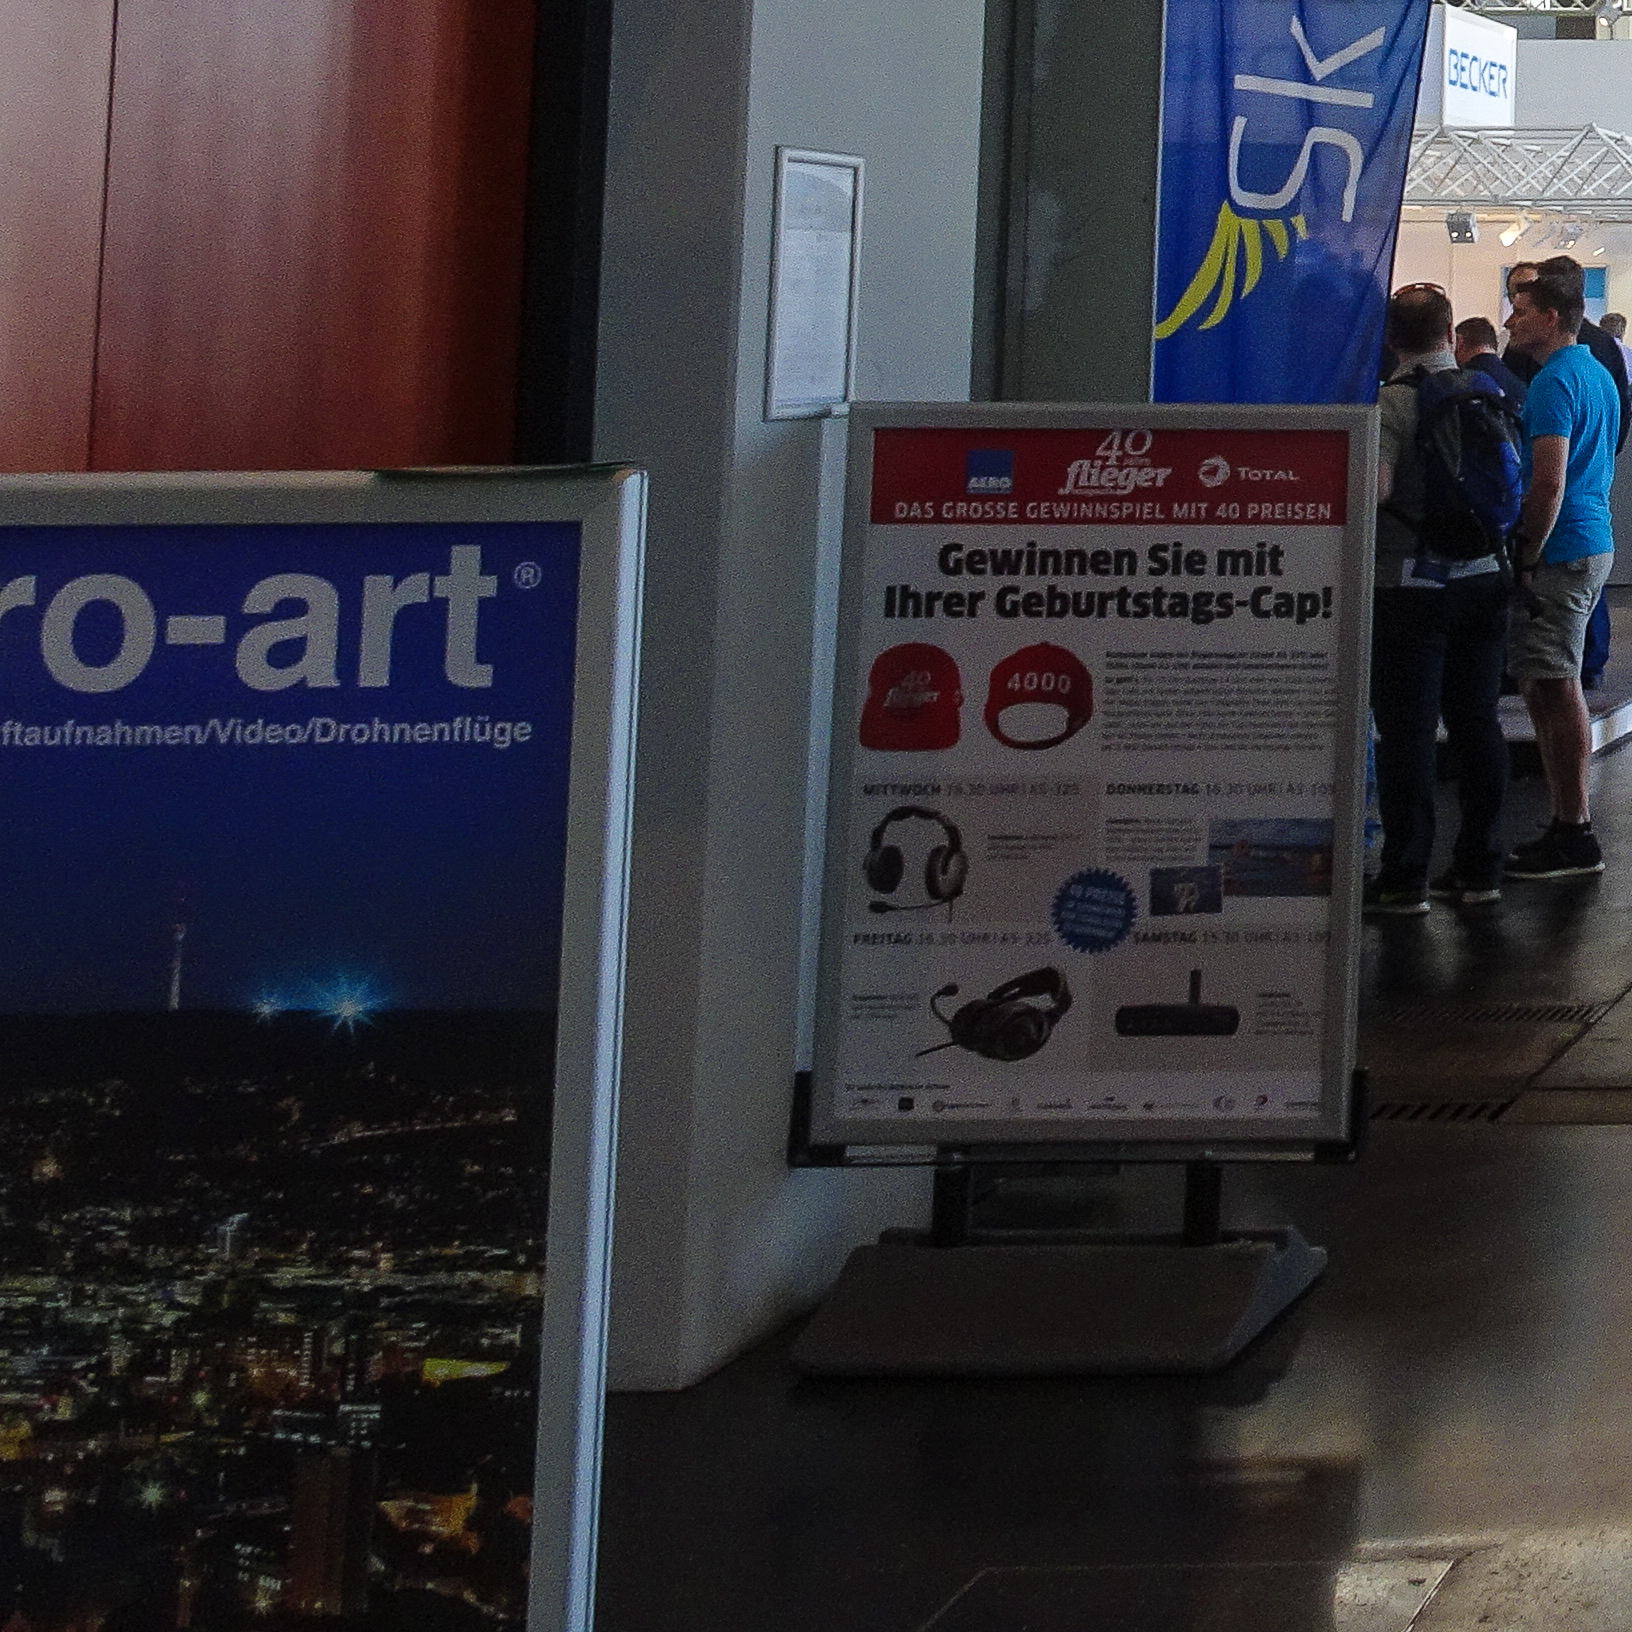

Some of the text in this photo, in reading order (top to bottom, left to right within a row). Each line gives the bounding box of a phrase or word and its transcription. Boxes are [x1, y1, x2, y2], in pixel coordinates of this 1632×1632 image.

[1448, 48, 1508, 100] BECKER
[1237, 466, 1300, 481] TOTAL
[895, 501, 1332, 521] DAS GROSSE GEWINNSPIEL MIT 40 PREISEN
[938, 540, 1285, 578] Gewinnen Sie mit
[883, 584, 1334, 626] Ihrer Geburtstags-Cap!
[1006, 671, 1073, 696] 4000
